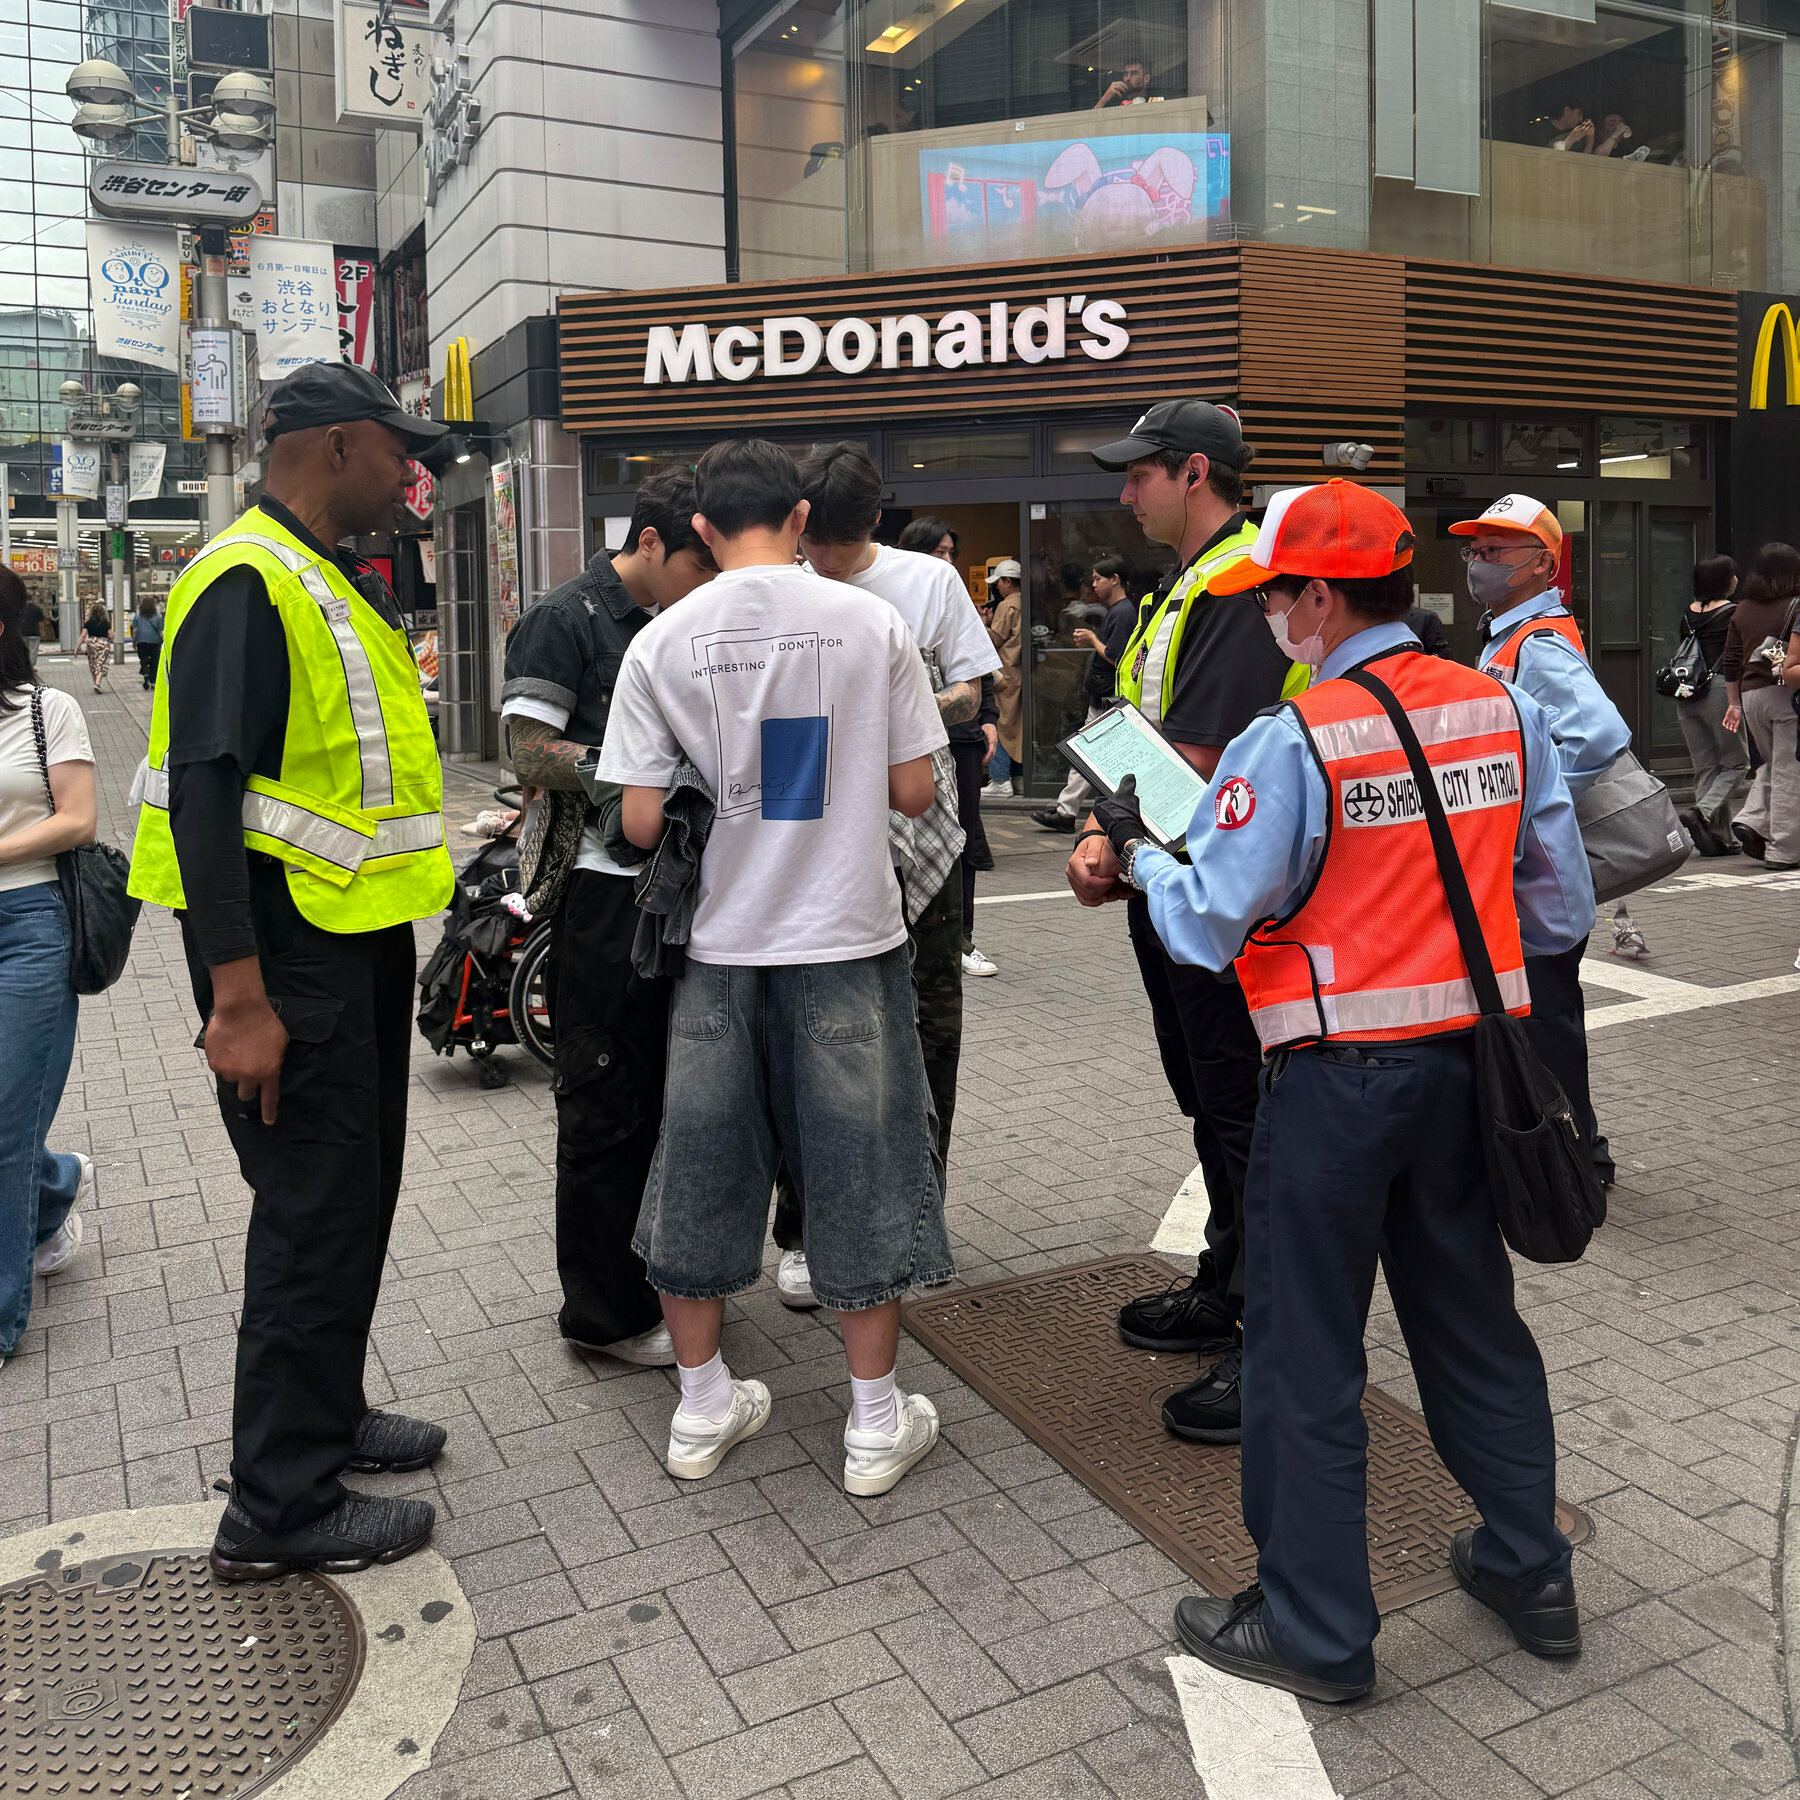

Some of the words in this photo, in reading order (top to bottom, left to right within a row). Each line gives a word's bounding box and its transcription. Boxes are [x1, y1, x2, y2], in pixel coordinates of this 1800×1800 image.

[365, 14, 407, 107] ねぎし
[99, 174, 251, 203] 渋谷センター街
[257, 217, 270, 228] 3F
[340, 264, 369, 281] 2F
[277, 279, 314, 296] 渋谷
[103, 292, 172, 316] Sunday
[261, 298, 331, 317] おとなり
[262, 317, 334, 334] サンデー
[643, 294, 1131, 385] McDonald's
[778, 639, 815, 651] DON'T
[820, 639, 844, 647] FOR
[691, 661, 766, 679] INTERESTING
[1387, 776, 1426, 819] SHIBU
[1442, 768, 1472, 808] CITY
[1477, 760, 1518, 802] PATROL
